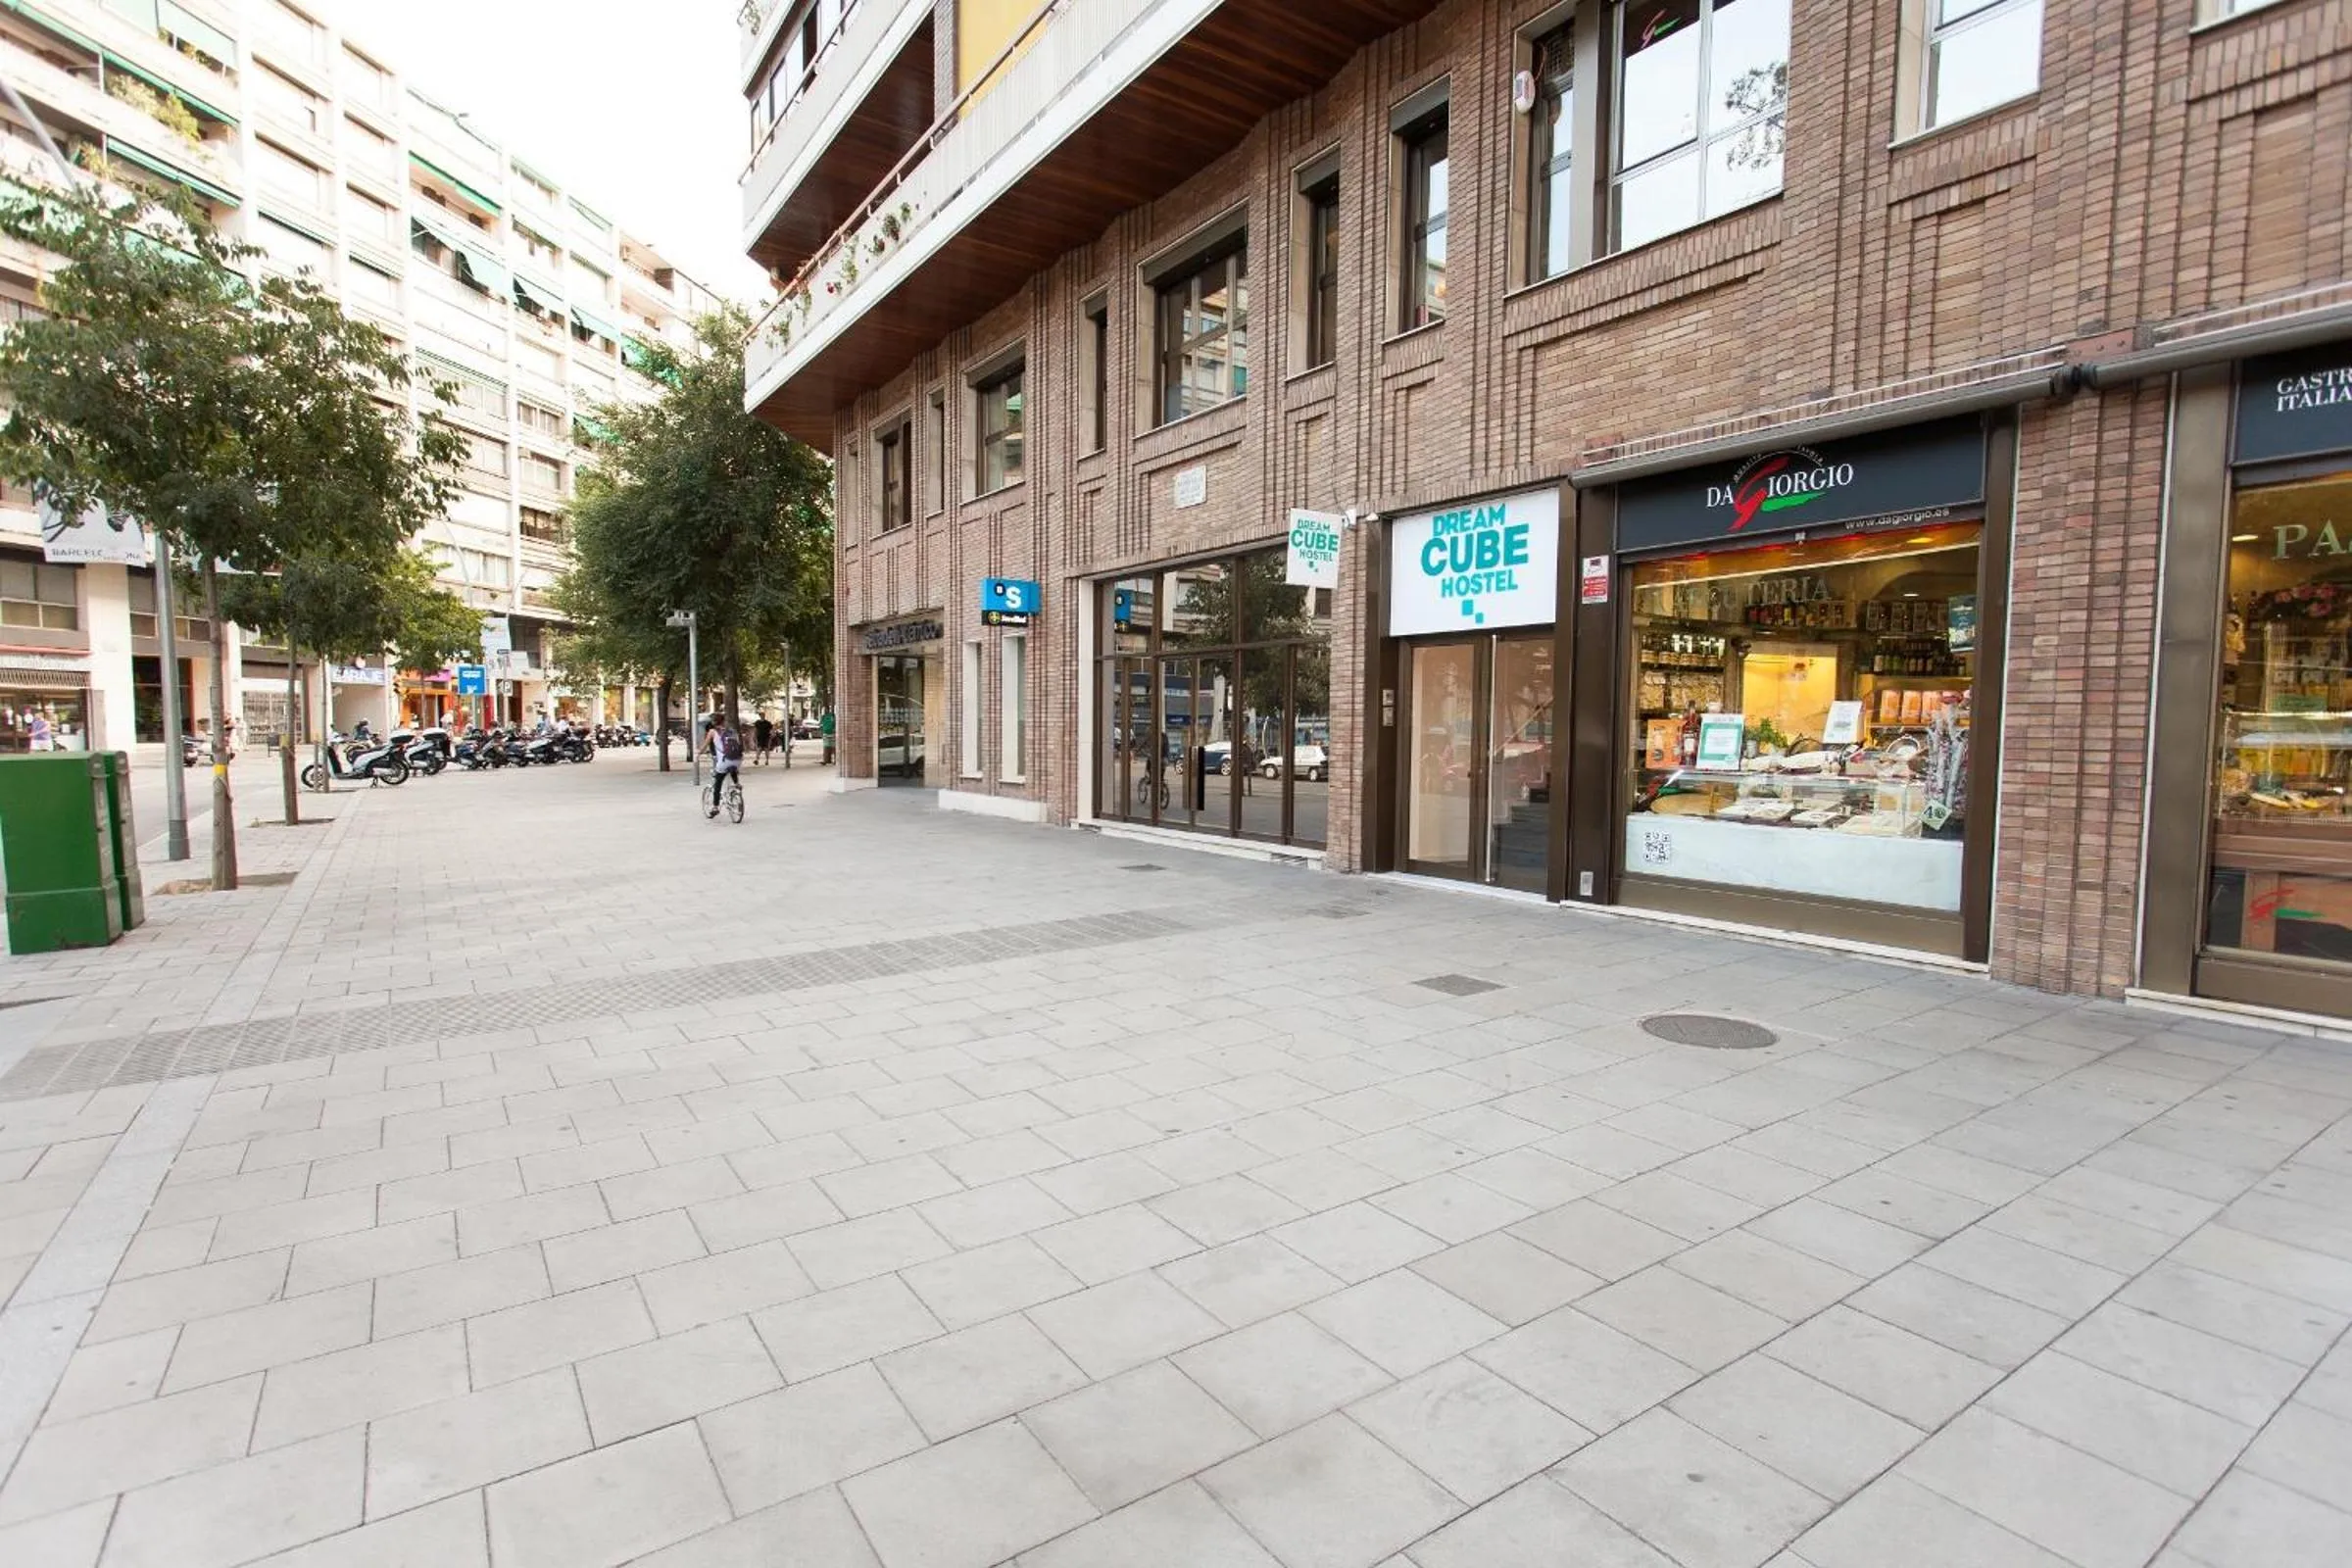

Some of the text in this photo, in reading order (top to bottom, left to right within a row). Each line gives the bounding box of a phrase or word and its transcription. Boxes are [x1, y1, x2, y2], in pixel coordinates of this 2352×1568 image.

[1706, 484, 1734, 508] DA
[1298, 518, 1331, 531] DREAM
[1432, 504, 1506, 536] DREAM
[1844, 508, 1950, 529] www.dagiorgio.es
[1291, 529, 1339, 552] CUBE
[1421, 523, 1530, 576] CUBE
[2271, 519, 2352, 561] PA
[1298, 549, 1333, 562] HOSTEL
[1441, 568, 1519, 598] HOSTEL
[1005, 586, 1021, 609] S
